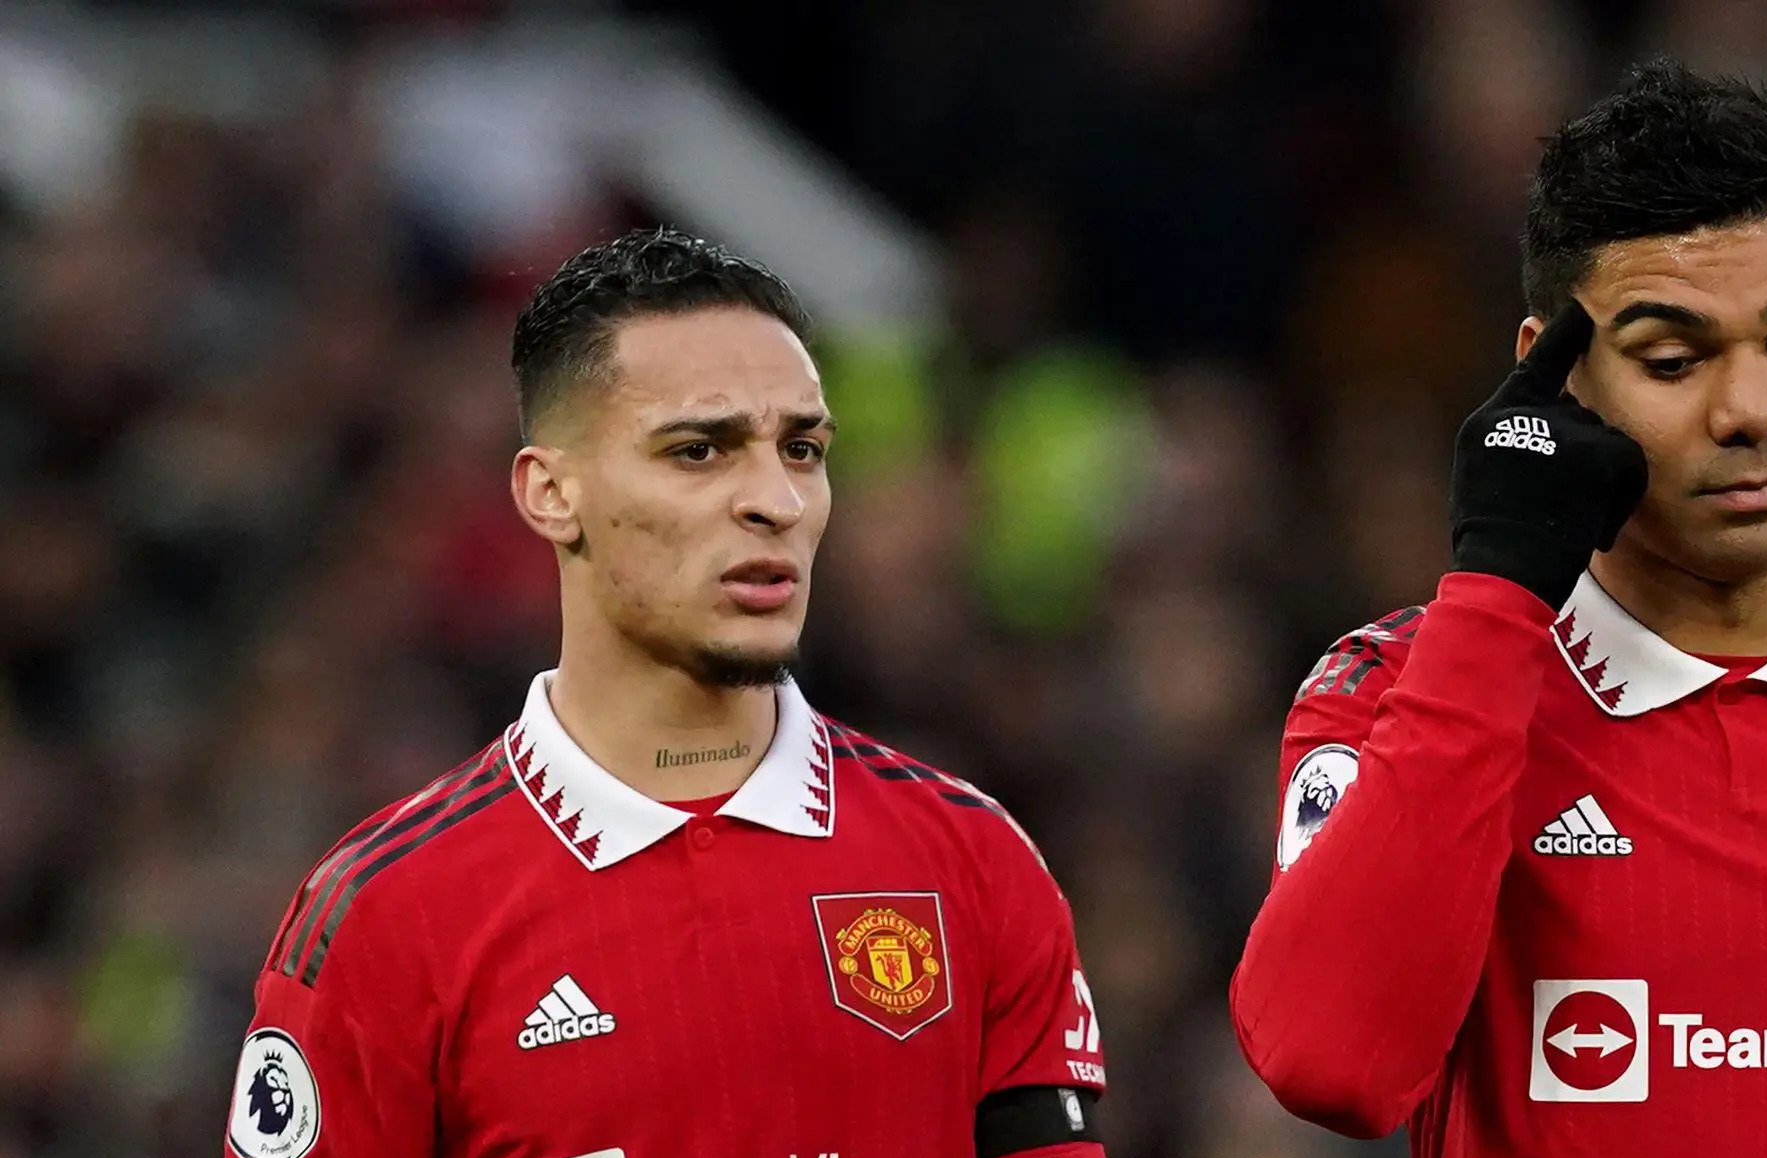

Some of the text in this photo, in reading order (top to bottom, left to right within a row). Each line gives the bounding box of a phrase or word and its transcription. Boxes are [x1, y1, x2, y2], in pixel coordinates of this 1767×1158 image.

[1484, 430, 1557, 455] adidas
[656, 740, 750, 768] Iluminado
[1534, 833, 1633, 855] adidas
[845, 915, 926, 949] MANCHESTER
[869, 987, 923, 1006] UNITED
[517, 1012, 616, 1050] adidas
